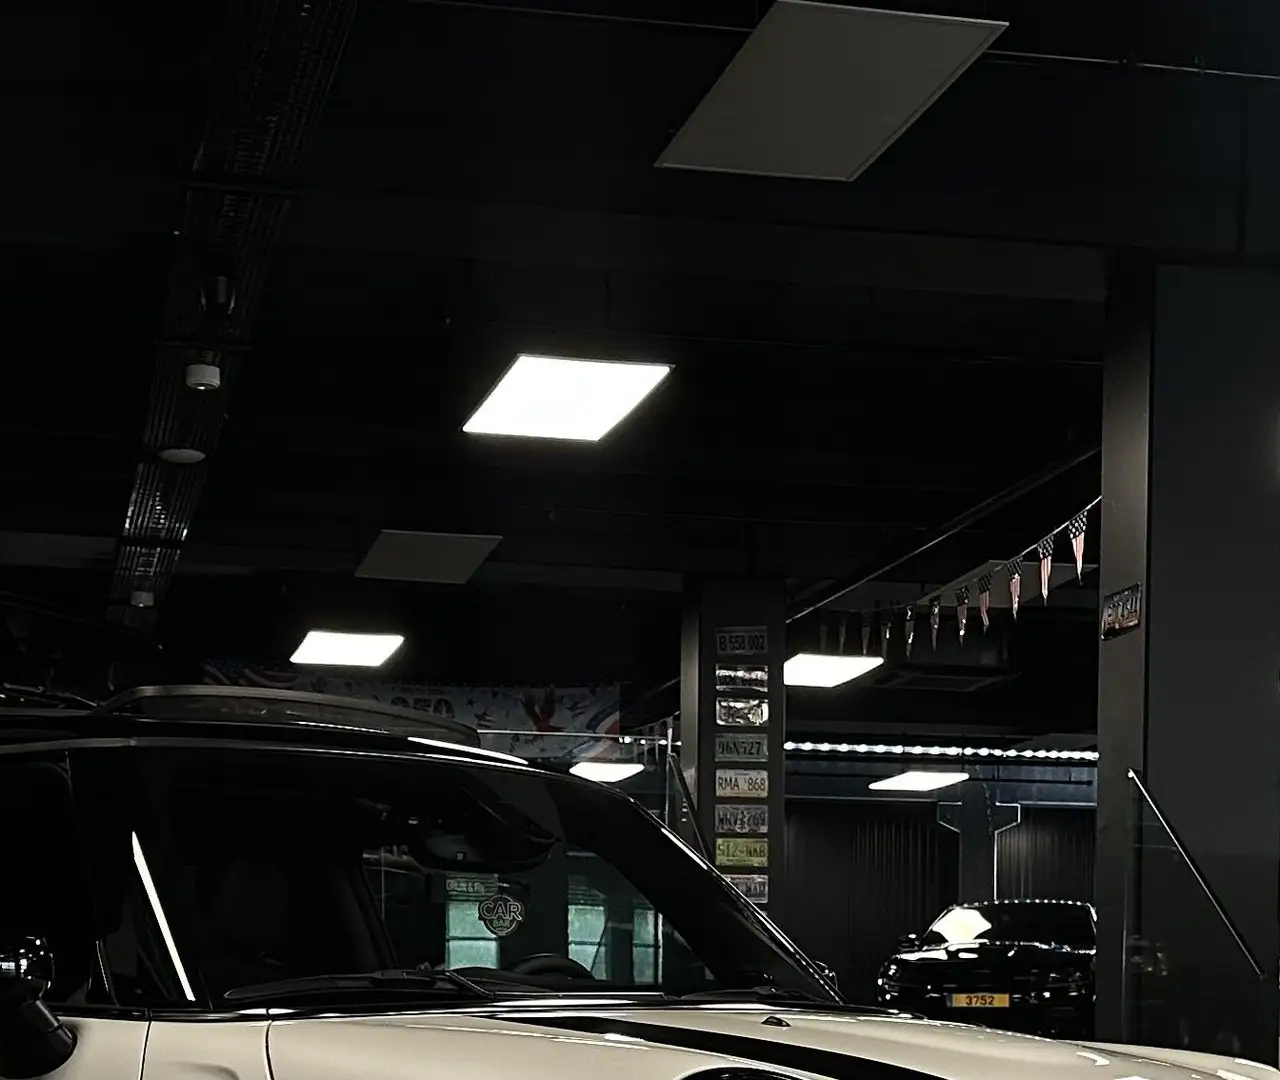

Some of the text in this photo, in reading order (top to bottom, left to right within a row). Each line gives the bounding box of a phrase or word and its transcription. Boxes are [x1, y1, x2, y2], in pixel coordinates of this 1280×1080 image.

[719, 635, 727, 652] B
[718, 776, 766, 791] RMA 868
[480, 901, 523, 920] CAR
[965, 995, 995, 1006] 3752
